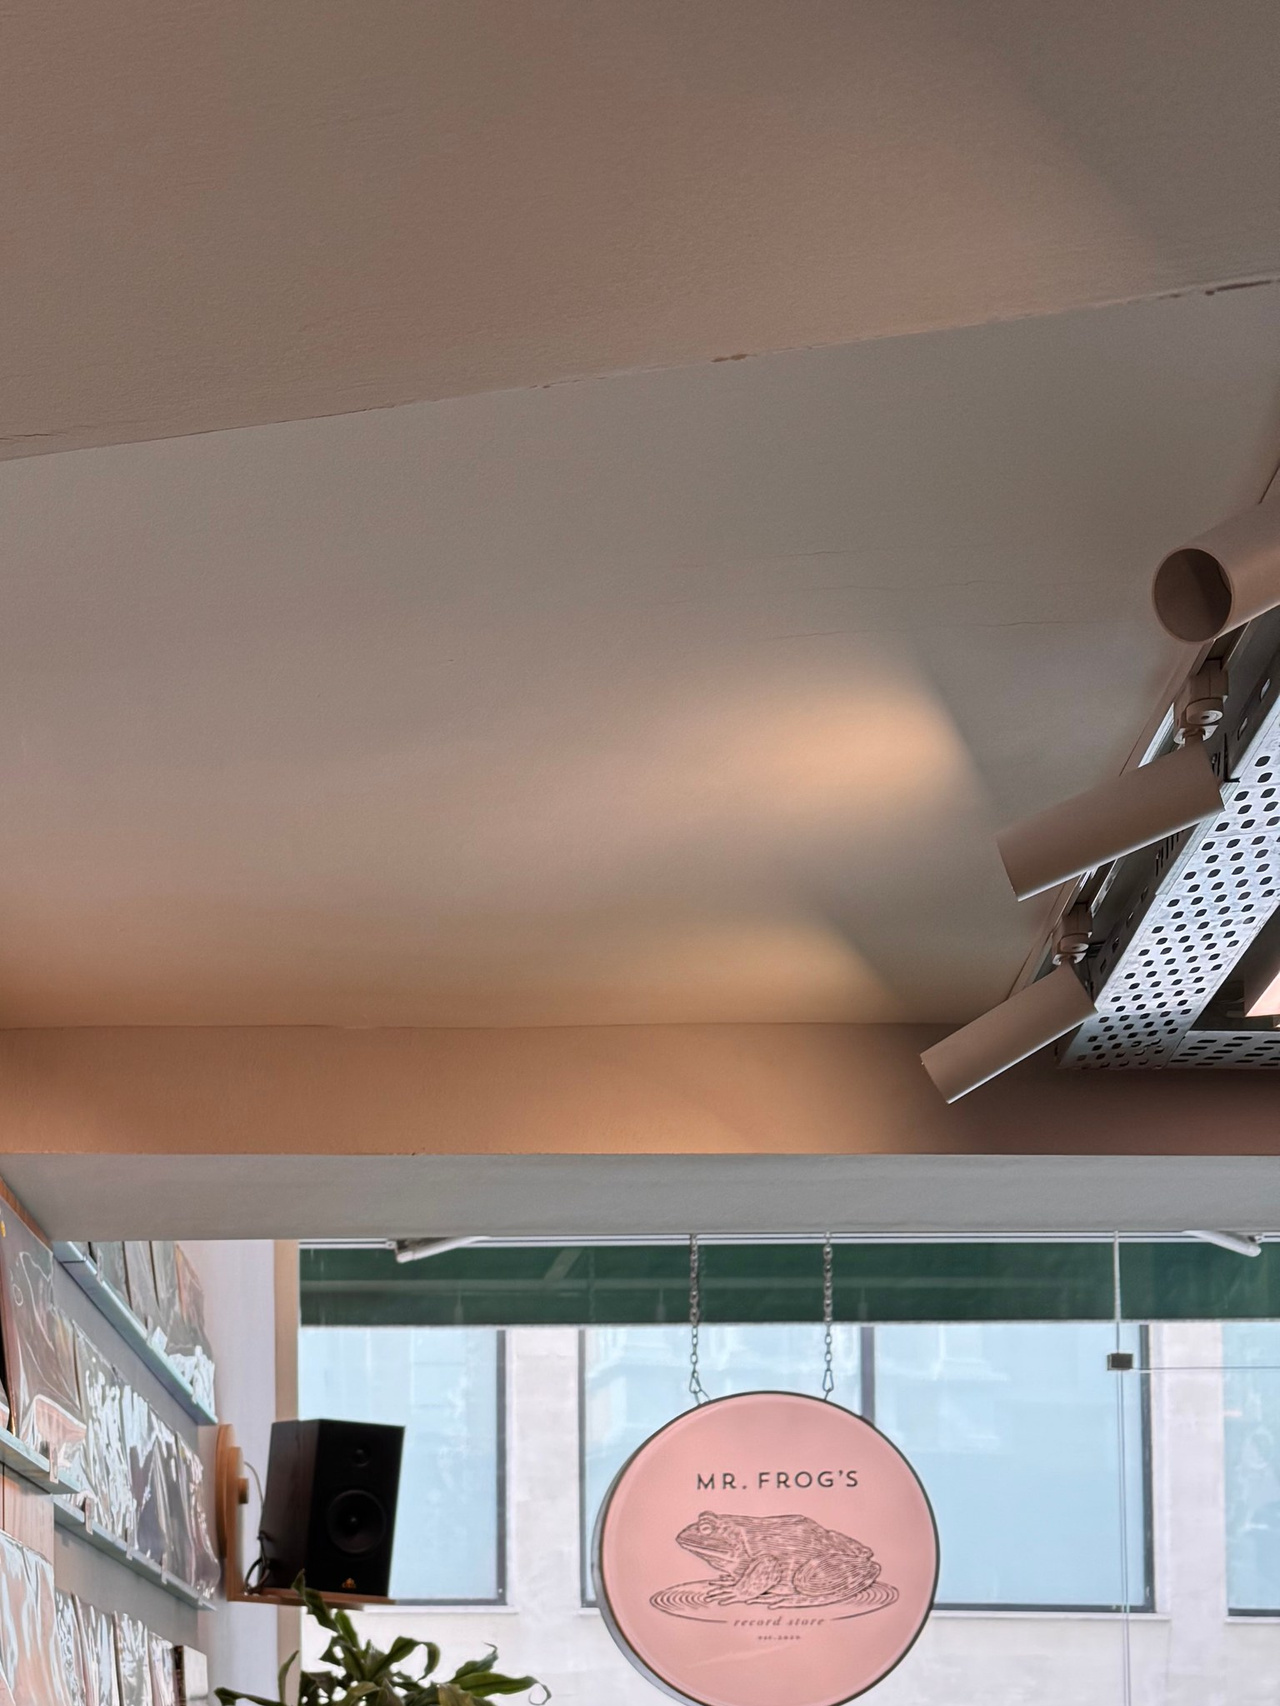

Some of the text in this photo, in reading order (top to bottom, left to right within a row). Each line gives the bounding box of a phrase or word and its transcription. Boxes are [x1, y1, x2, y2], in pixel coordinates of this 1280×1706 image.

[696, 1470, 859, 1491] MR. FROG'S
[734, 1616, 825, 1627] record store
